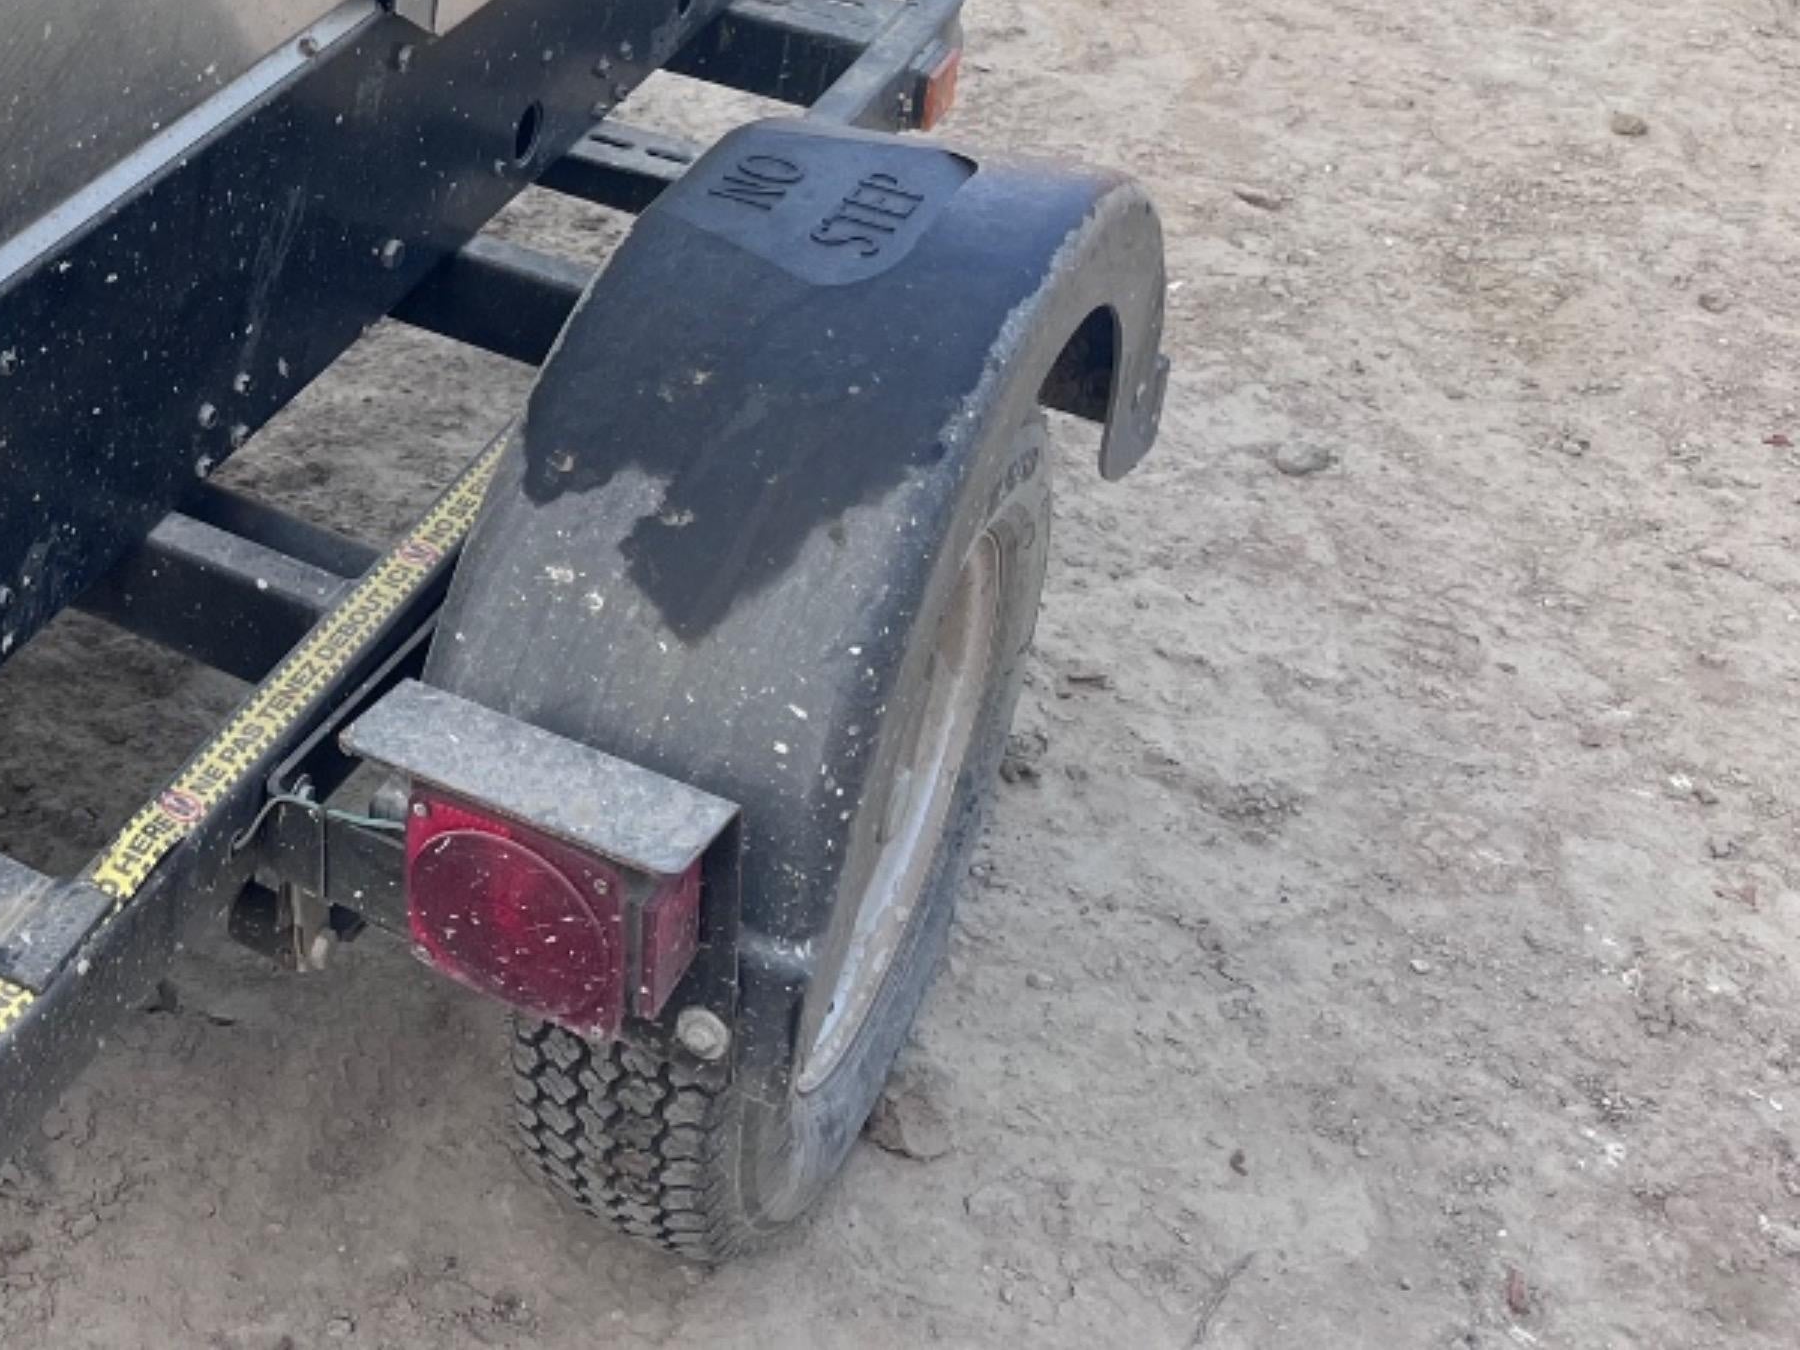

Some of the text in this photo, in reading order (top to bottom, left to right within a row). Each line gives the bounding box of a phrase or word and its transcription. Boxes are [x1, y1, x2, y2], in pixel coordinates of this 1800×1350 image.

[706, 155, 805, 212] NO
[809, 172, 925, 258] STEP
[222, 721, 266, 763] PAS
[258, 660, 321, 723] TENEZ
[315, 588, 392, 661] DEBOUT
[111, 816, 174, 878] HERE
